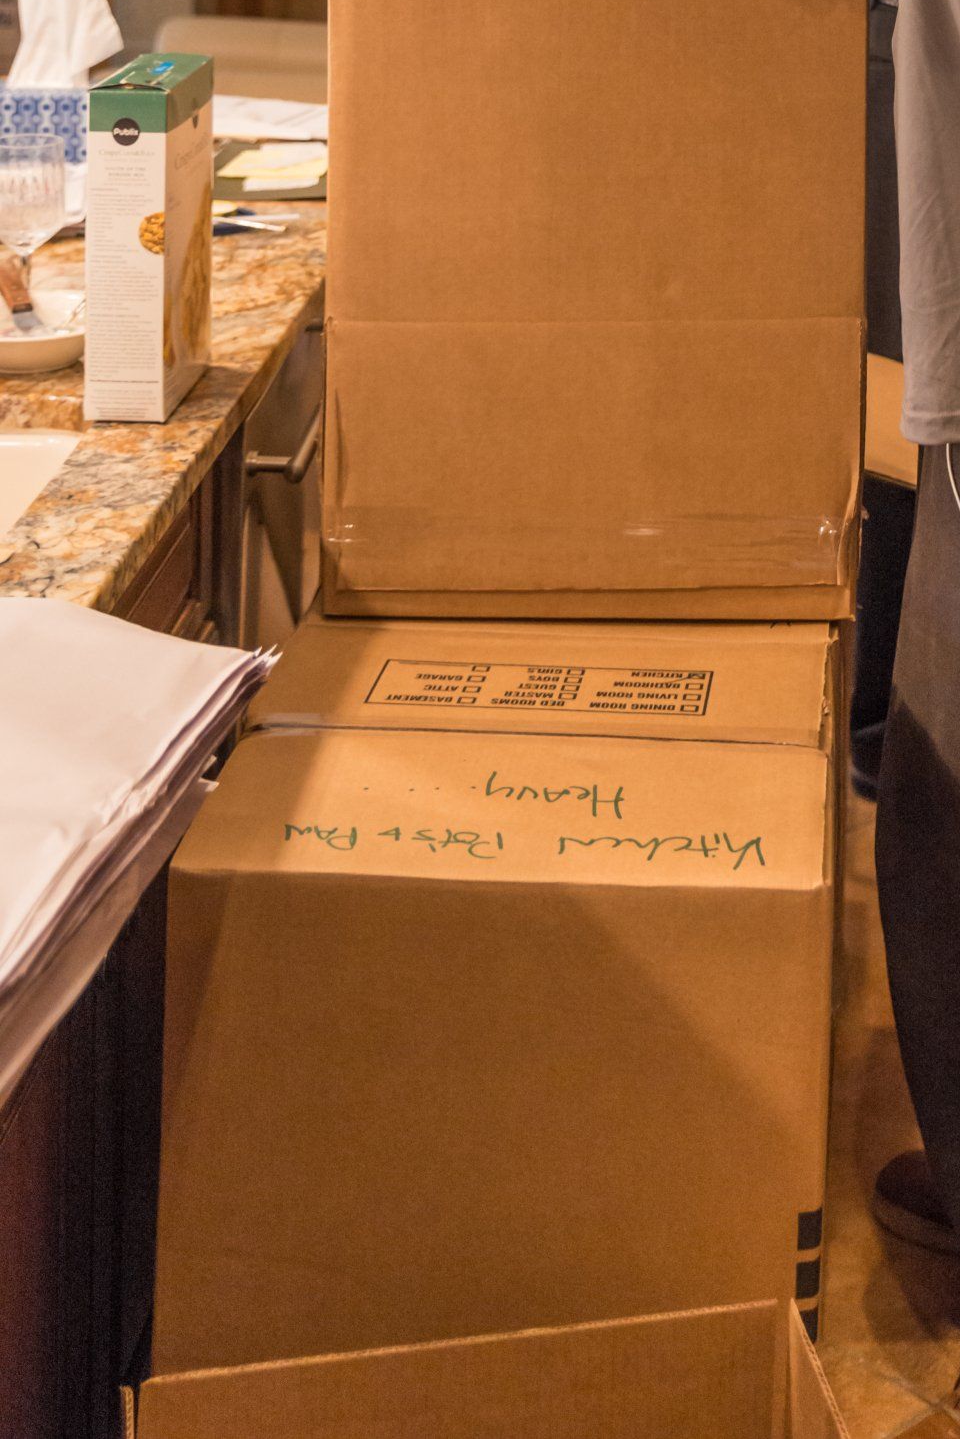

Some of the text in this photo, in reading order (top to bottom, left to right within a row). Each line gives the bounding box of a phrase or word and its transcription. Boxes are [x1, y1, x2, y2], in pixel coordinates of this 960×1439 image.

[113, 128, 139, 137] Publix
[414, 673, 463, 681] GARAGE
[631, 671, 683, 679] KITCHEN
[423, 684, 459, 692] ATTIC
[385, 694, 453, 703] BASEMENT
[504, 691, 554, 699] MASTER
[596, 691, 678, 700] LIVING ROOM
[490, 698, 536, 706] ROOMS
[589, 702, 675, 711] DINING ROOM
